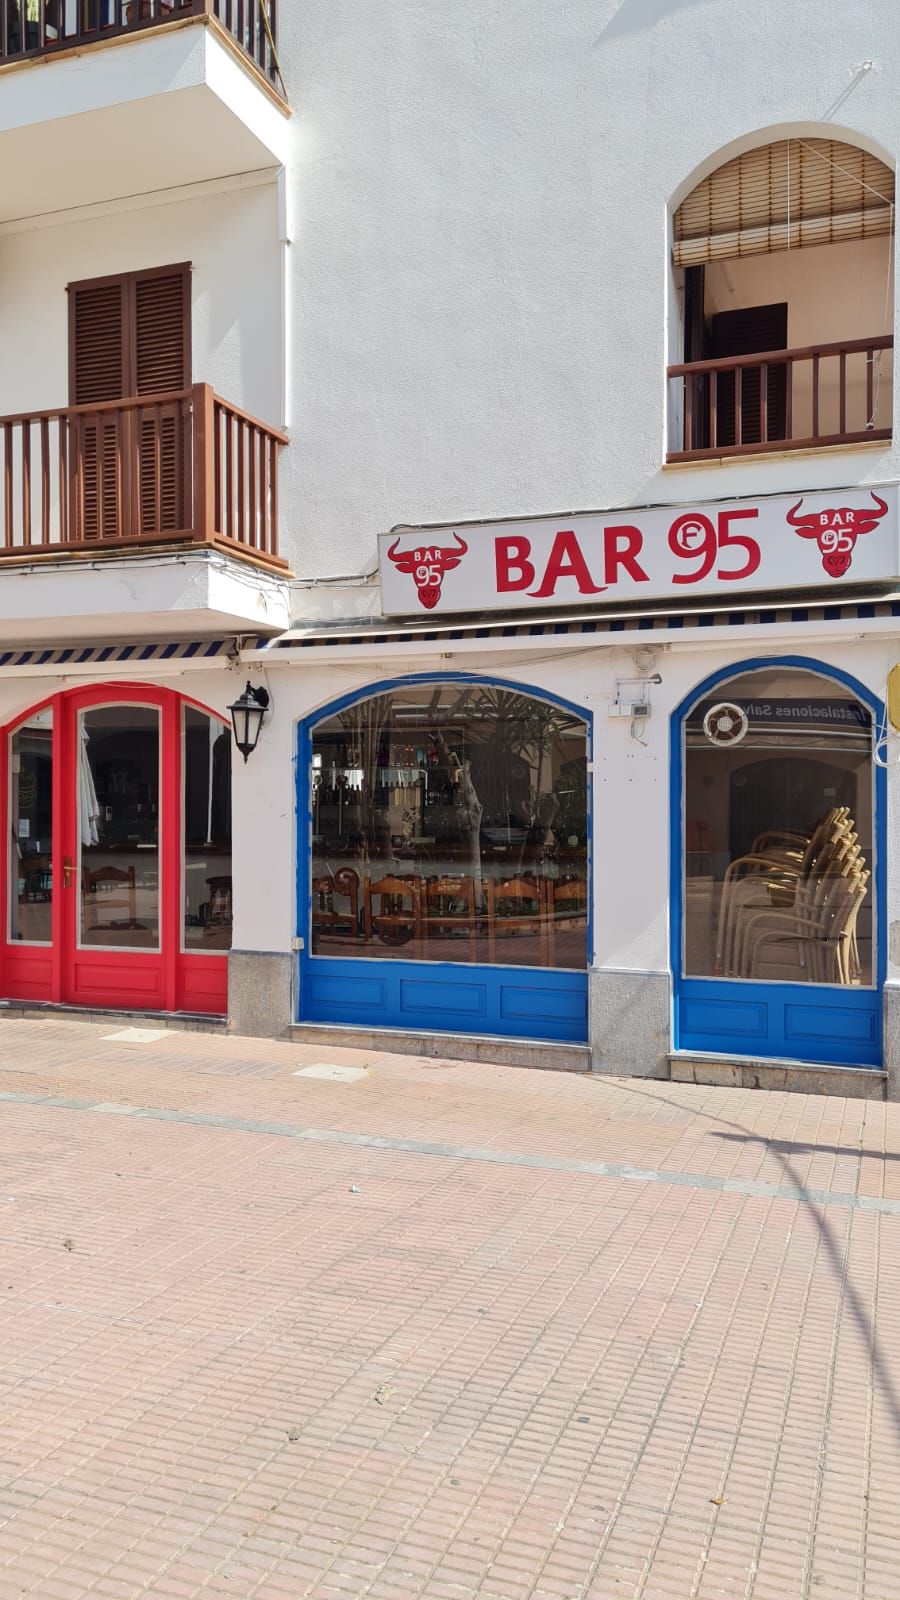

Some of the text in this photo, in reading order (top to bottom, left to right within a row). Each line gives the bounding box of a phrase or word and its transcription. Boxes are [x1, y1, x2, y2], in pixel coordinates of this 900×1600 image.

[820, 512, 855, 526] BAR
[821, 528, 853, 553] 95
[414, 550, 442, 562] BAR
[495, 509, 761, 597] BAR 95
[416, 565, 441, 587] 95
